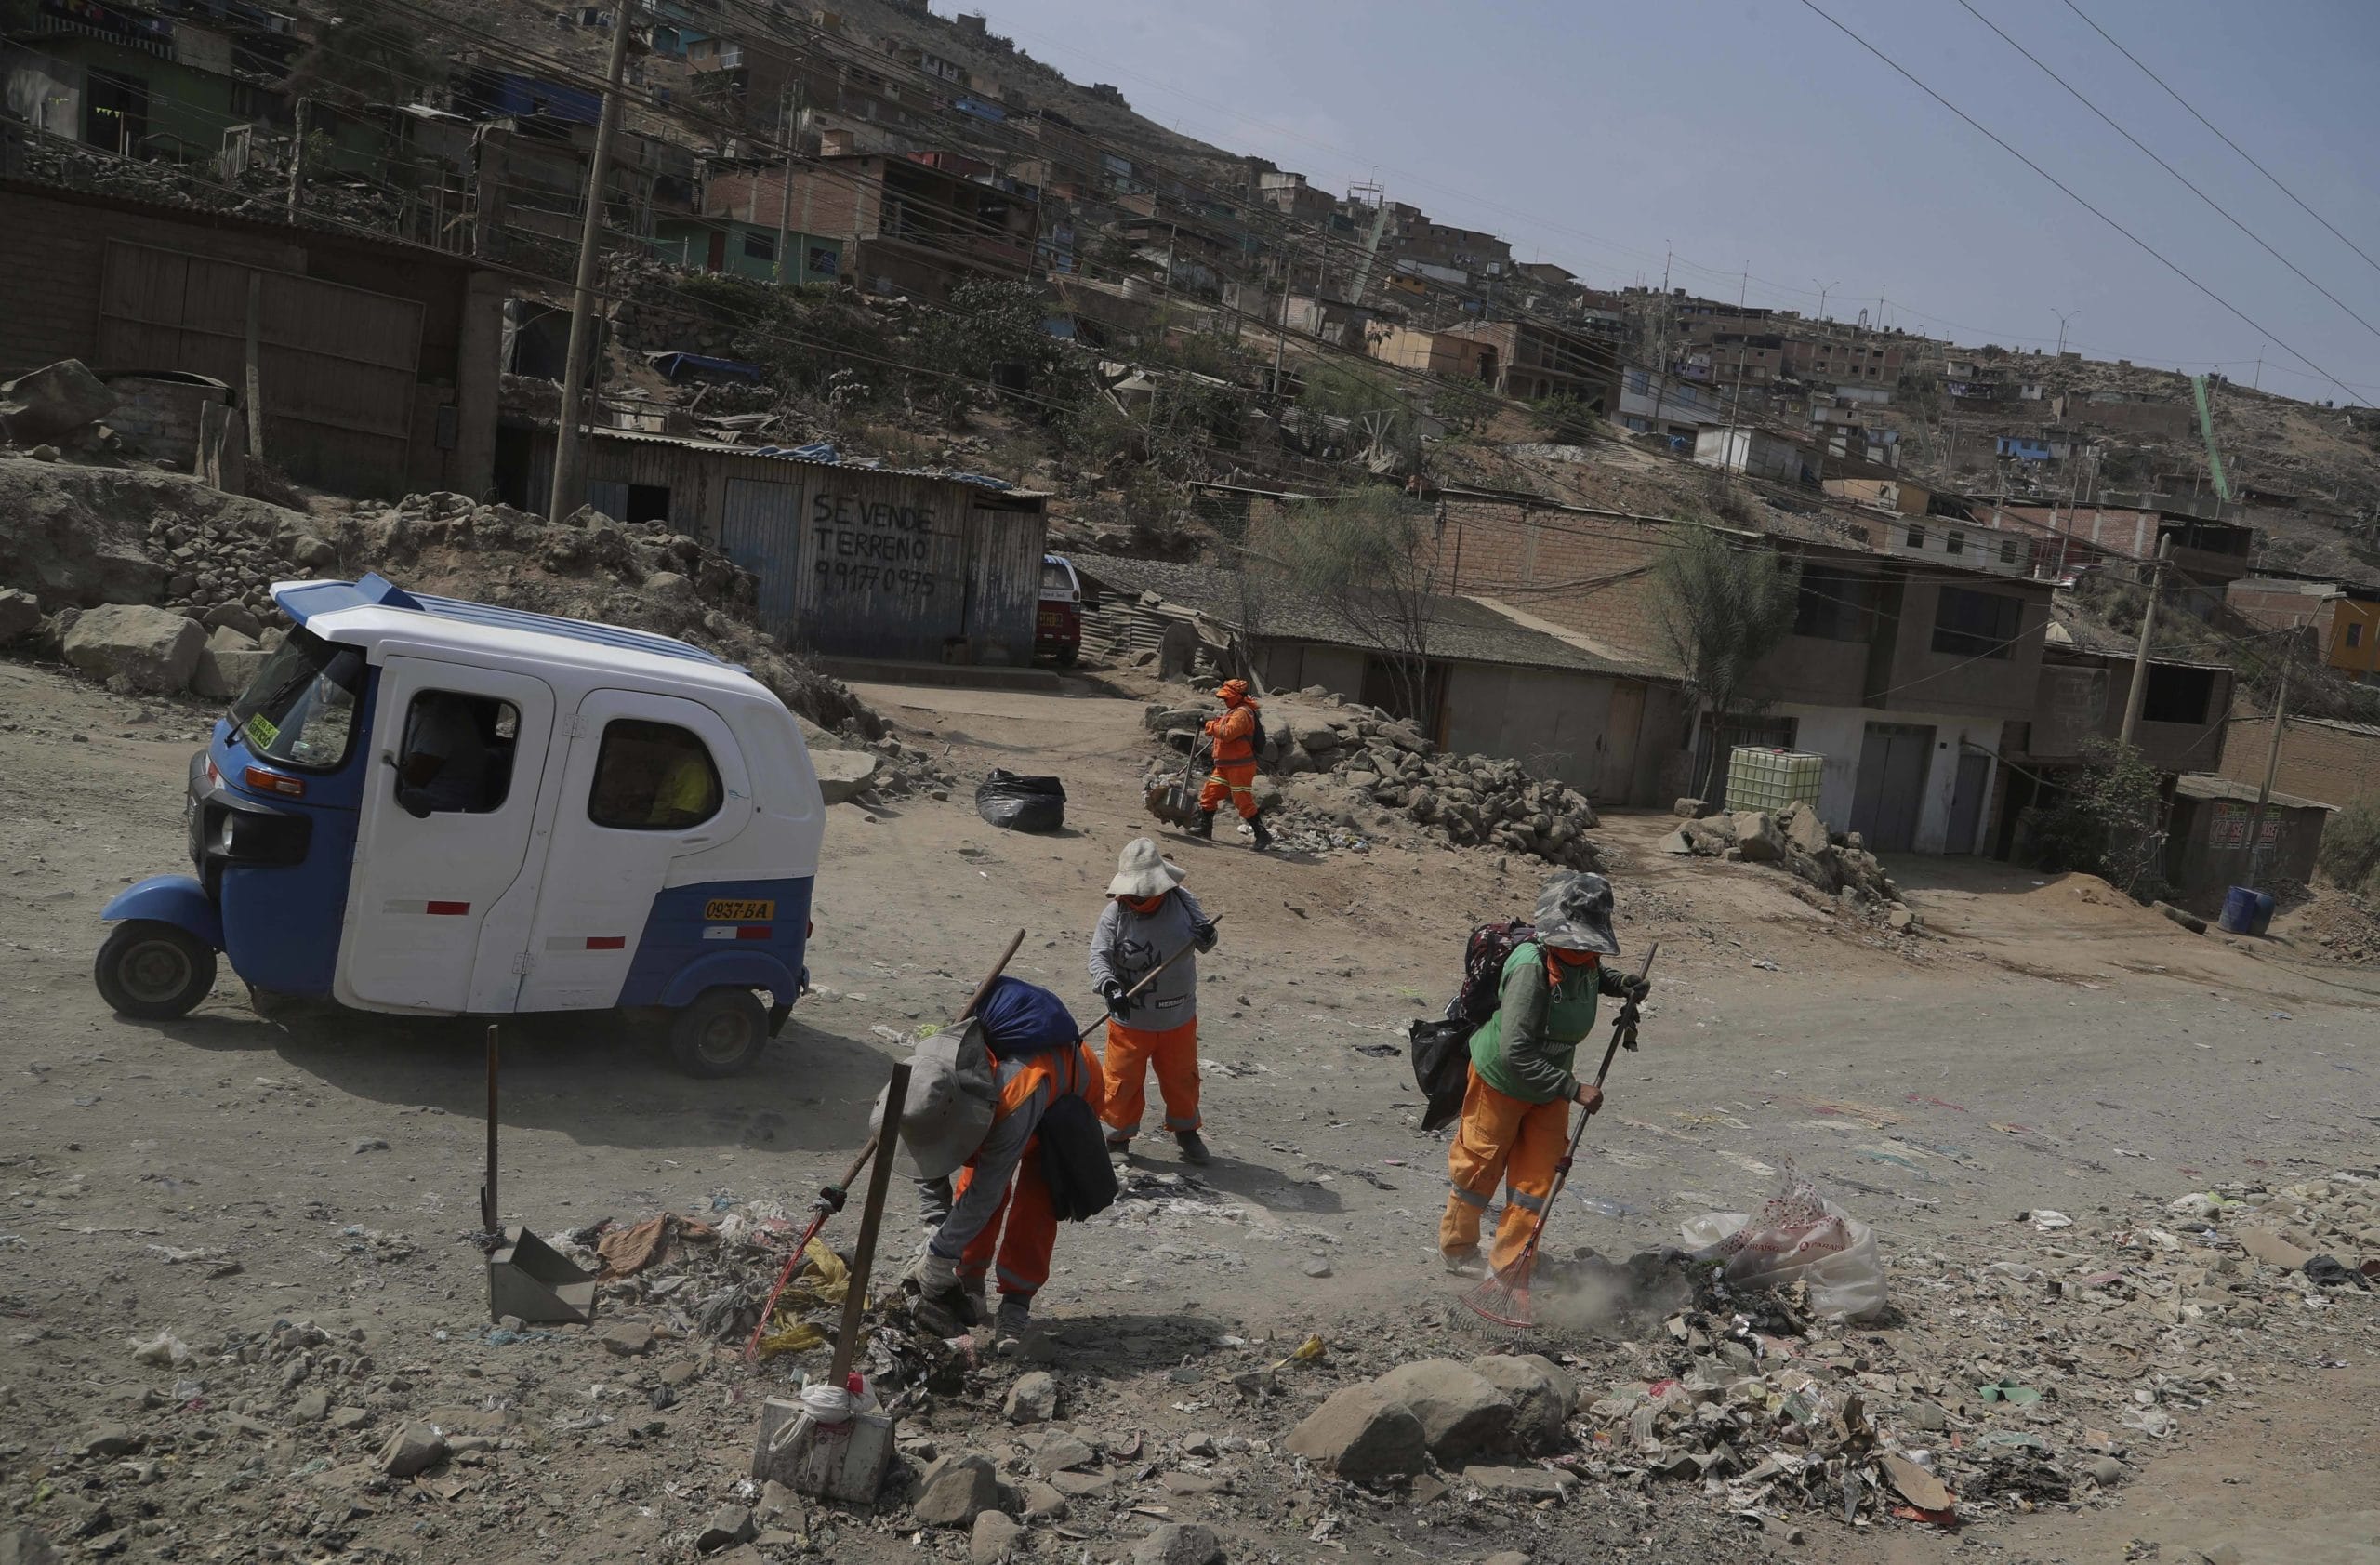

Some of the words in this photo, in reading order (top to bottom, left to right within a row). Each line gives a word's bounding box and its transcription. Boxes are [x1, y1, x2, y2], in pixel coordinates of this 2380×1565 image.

[813, 494, 853, 524] SE
[858, 500, 935, 534] VENDE
[814, 527, 927, 561] TERRENO
